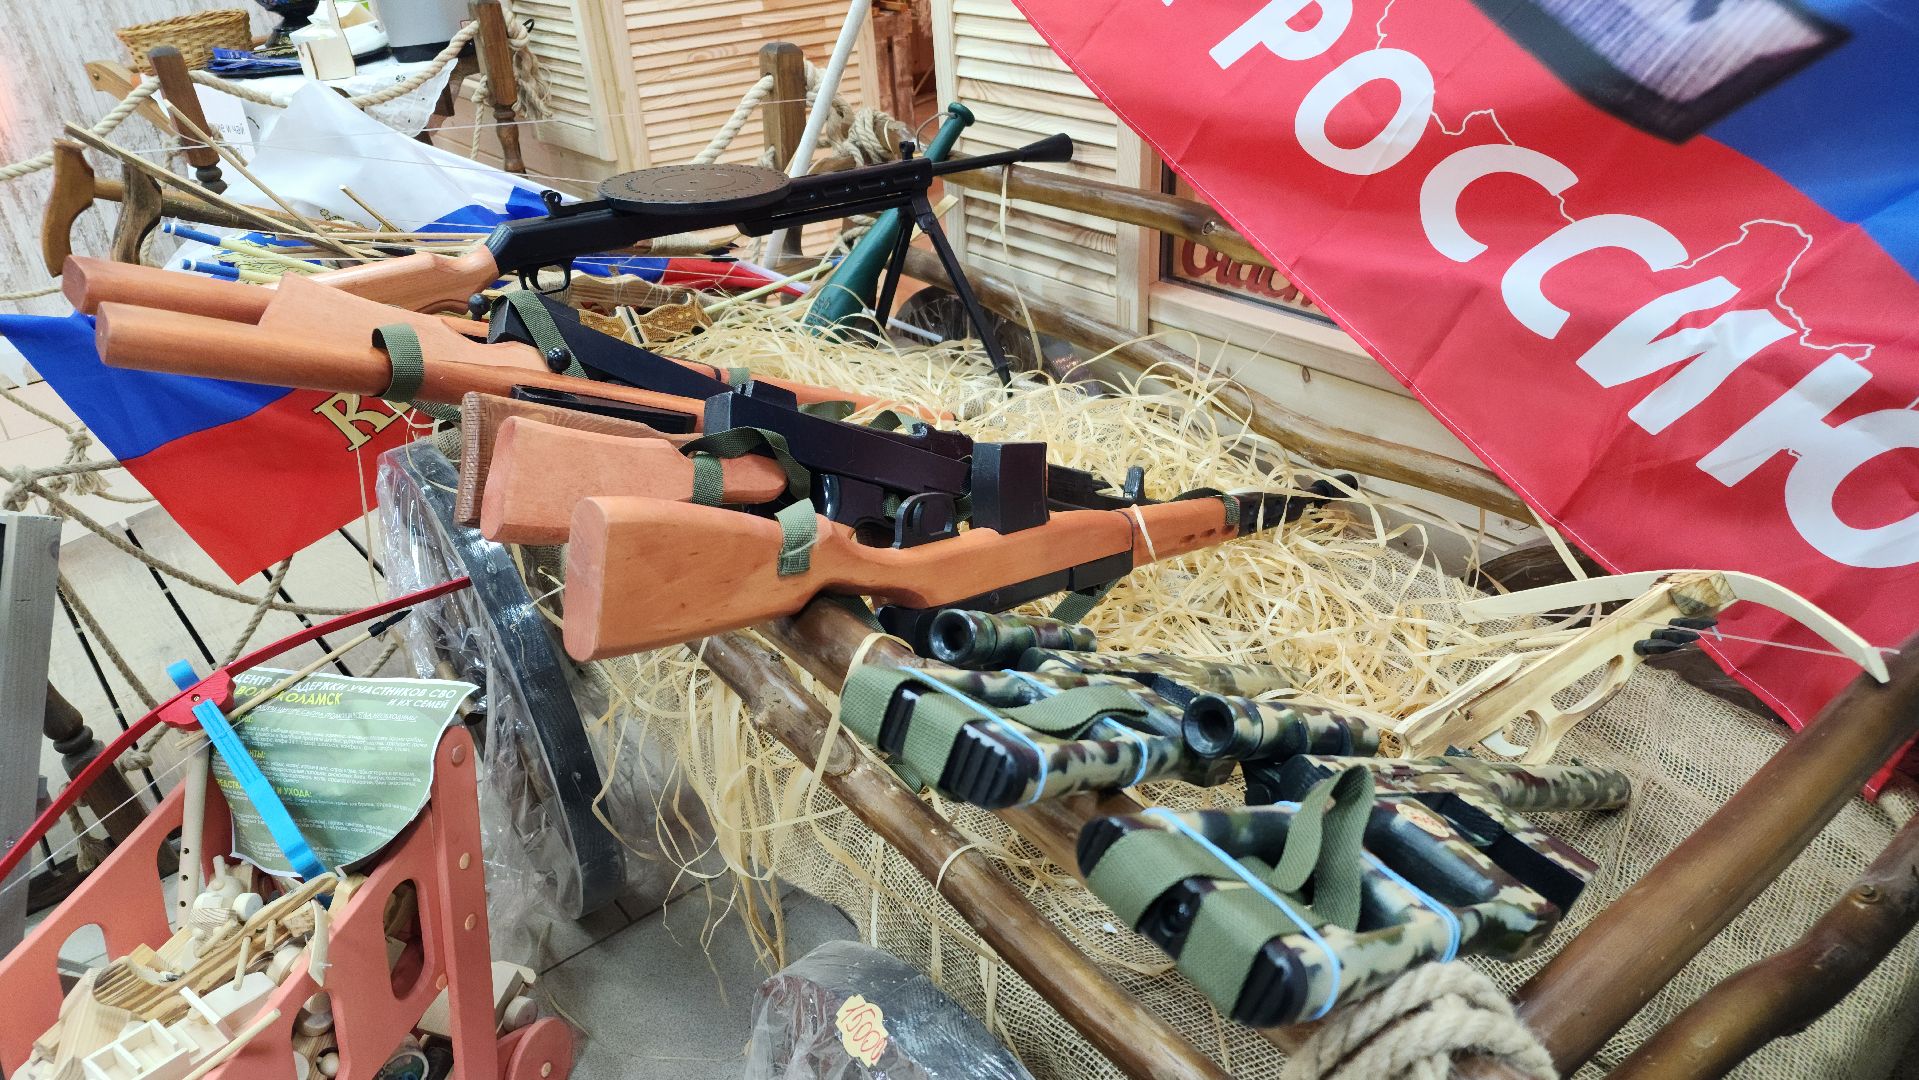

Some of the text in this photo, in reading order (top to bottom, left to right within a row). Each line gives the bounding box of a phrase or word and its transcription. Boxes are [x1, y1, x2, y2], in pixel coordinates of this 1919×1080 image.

[232, 674, 457, 700] ЦЕНТР ПДДЕРЖКИ УЧАСТНИКОВ СВО
[396, 699, 412, 708] ИХ
[413, 699, 451, 710] СЕМЕЙ
[283, 787, 313, 798] УХОДА:
